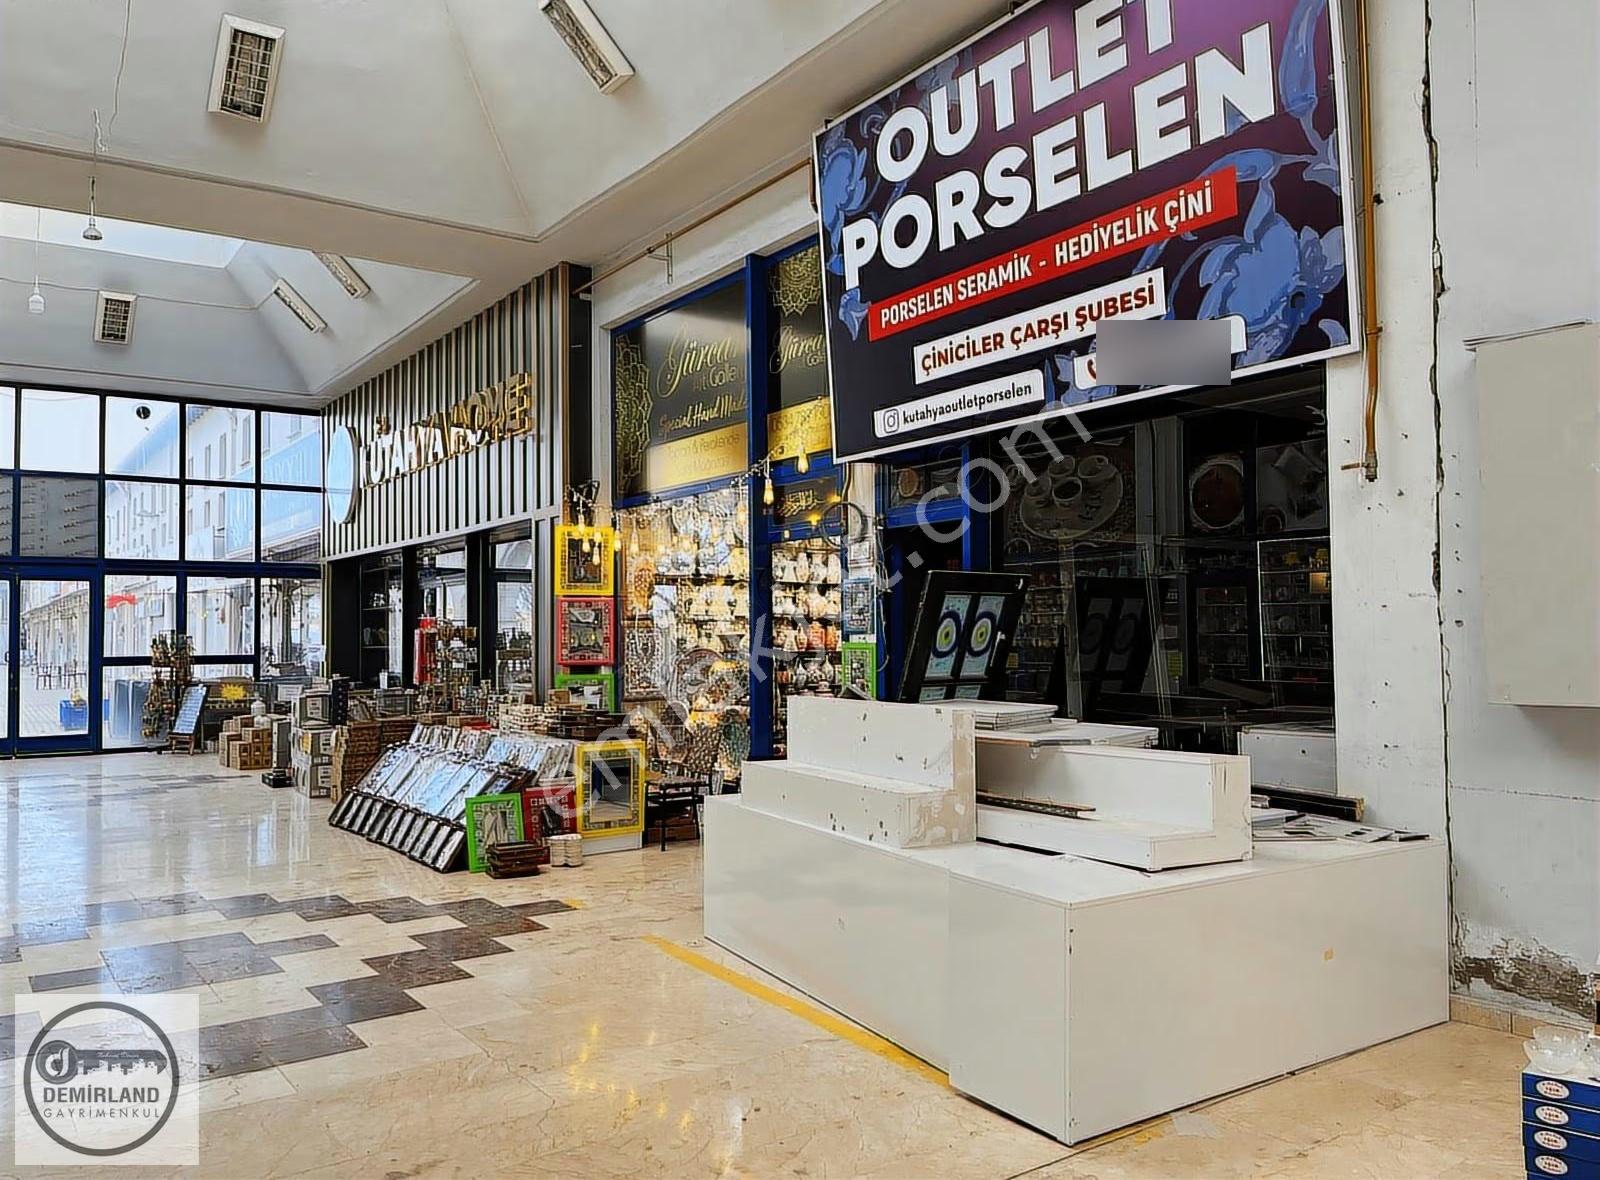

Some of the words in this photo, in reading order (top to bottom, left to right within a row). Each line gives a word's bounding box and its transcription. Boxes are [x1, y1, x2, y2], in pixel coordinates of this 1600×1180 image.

[843, 22, 1275, 290] PORSELEN
[881, 284, 953, 328] PORSELEN
[957, 253, 1033, 301] SERAMİK
[1055, 206, 1159, 266] HEDİYELİK
[1164, 180, 1213, 232] ÇİNİ
[921, 331, 1004, 377] ÇİNİCİLER
[1010, 311, 1069, 354] ÇARŞI
[1074, 277, 1155, 329] ŞUBESİ
[902, 382, 1032, 427] kutahyaoutletporselen
